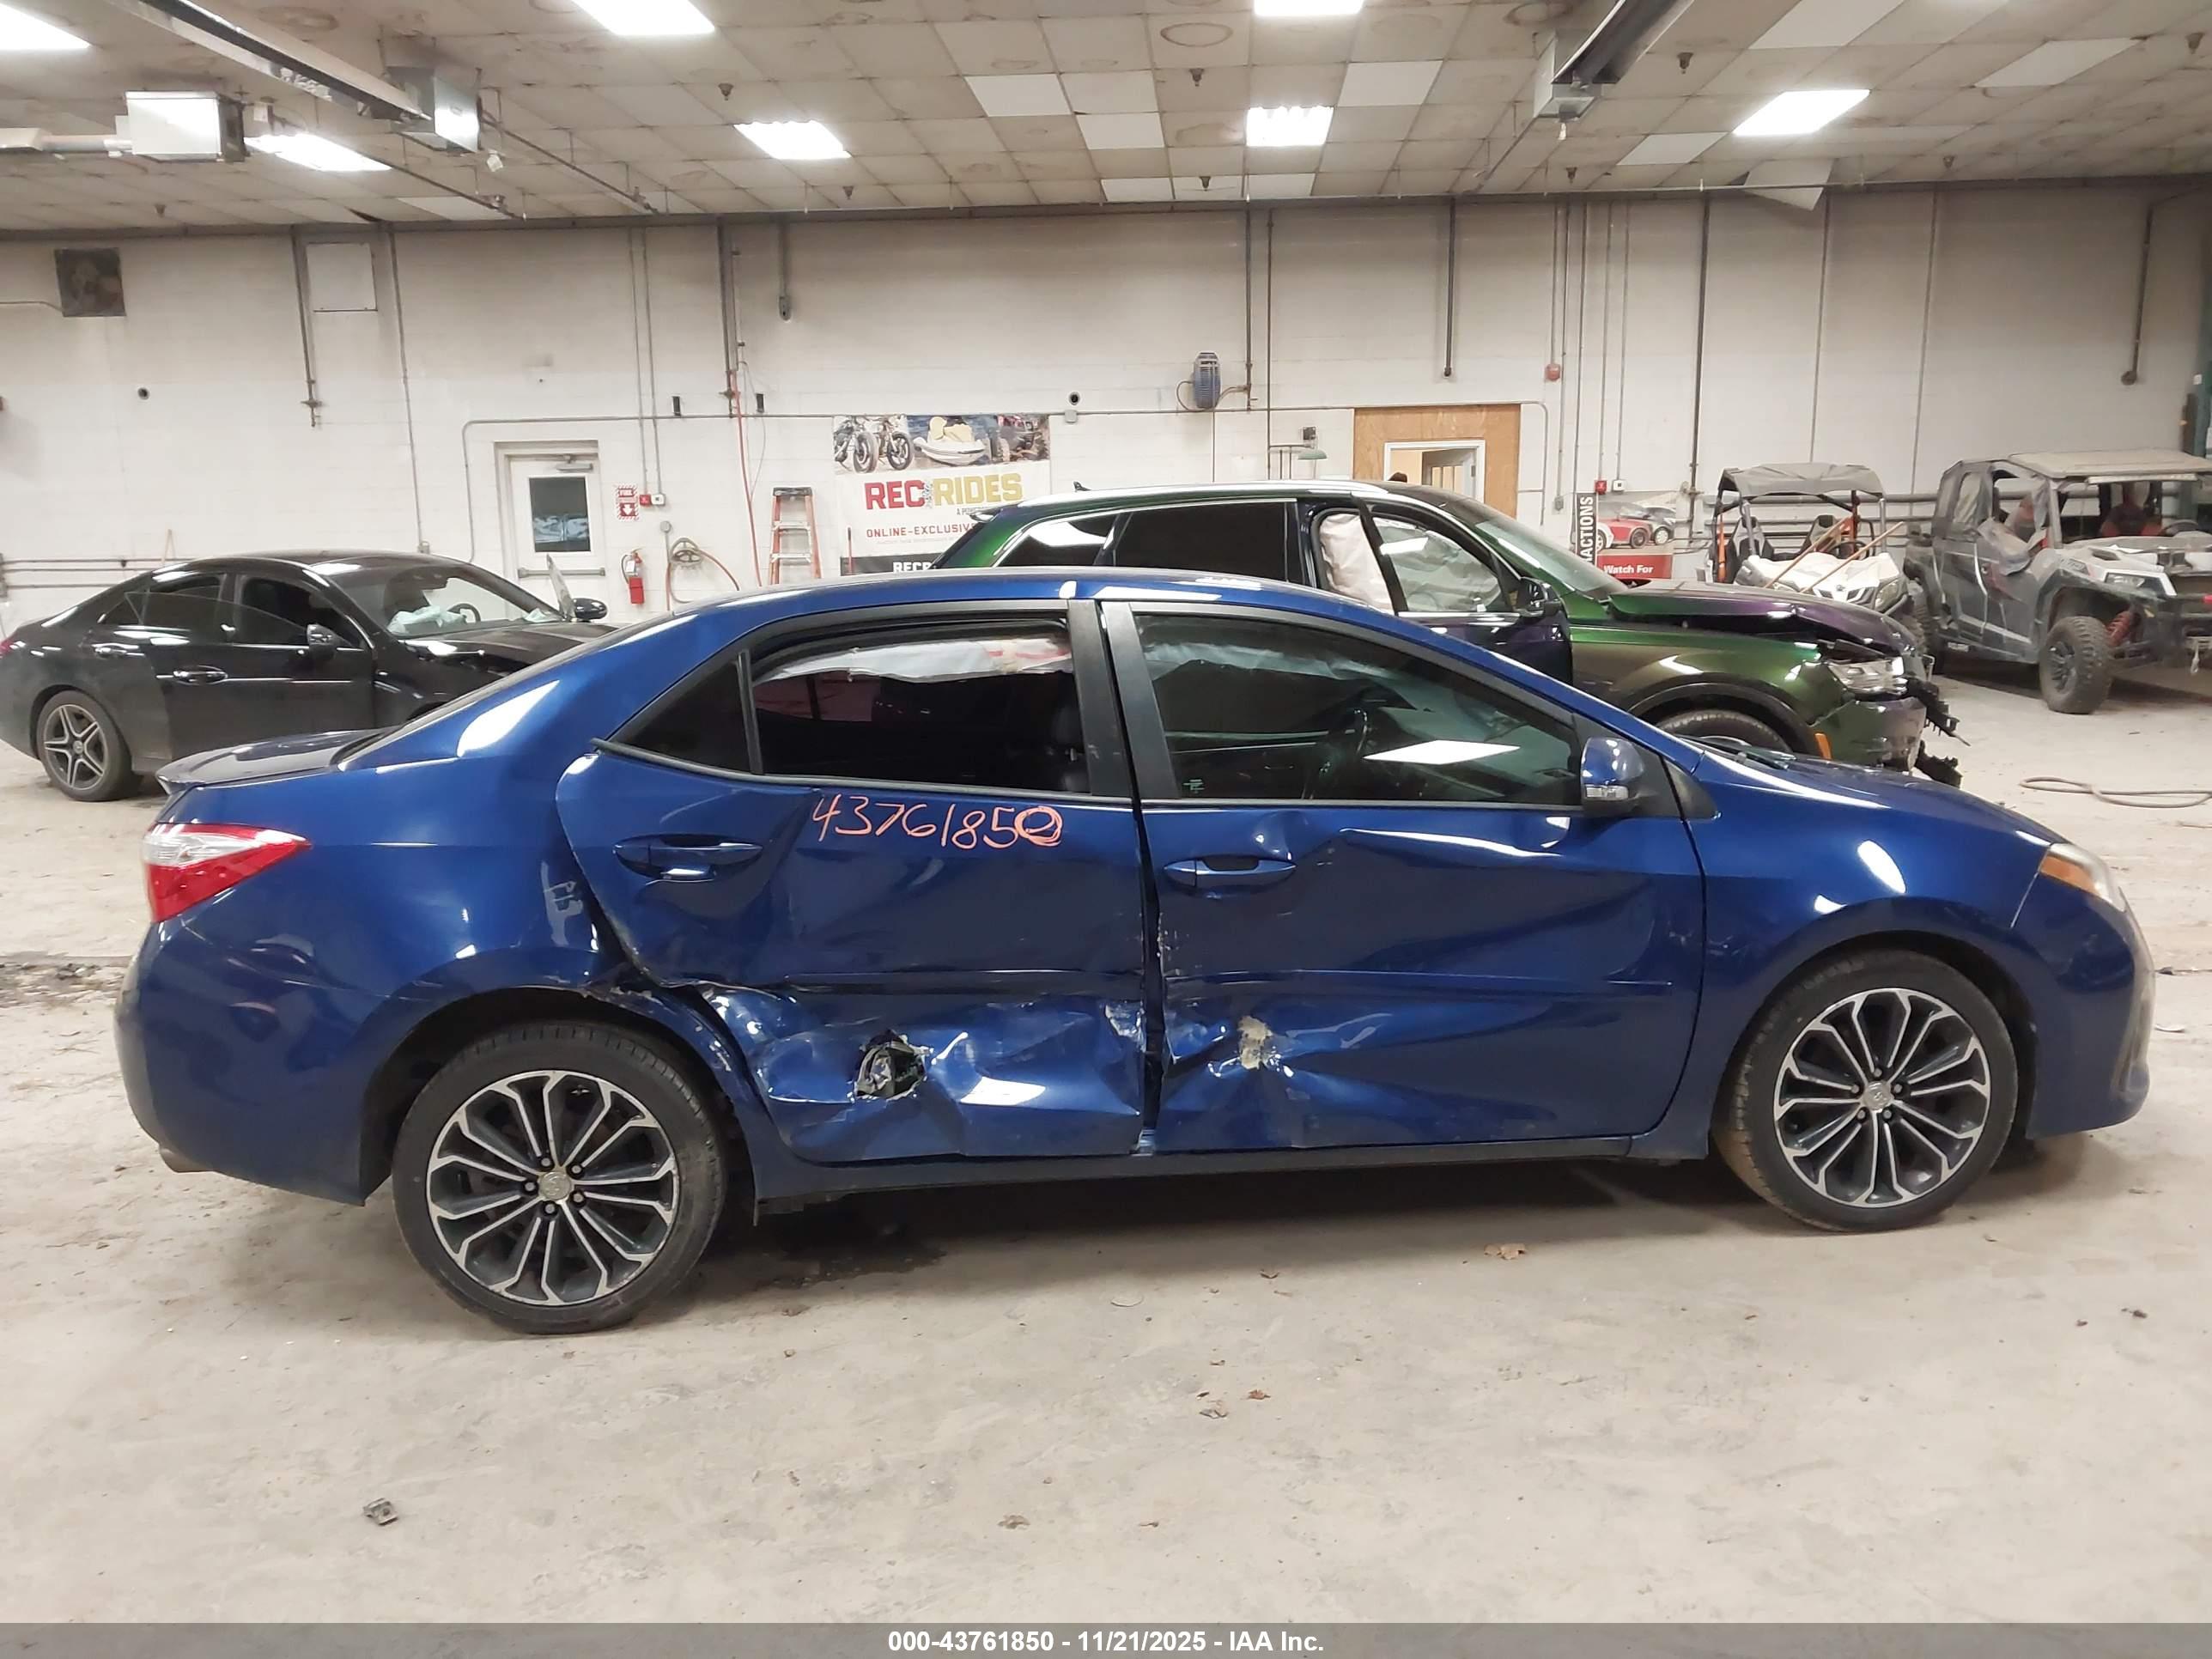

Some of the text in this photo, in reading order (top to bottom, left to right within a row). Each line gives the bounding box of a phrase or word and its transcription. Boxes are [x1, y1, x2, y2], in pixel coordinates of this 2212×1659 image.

[864, 473, 1023, 510] REC RIDES
[1580, 496, 1594, 562] ACTIONS
[1604, 564, 1654, 574] Watch For
